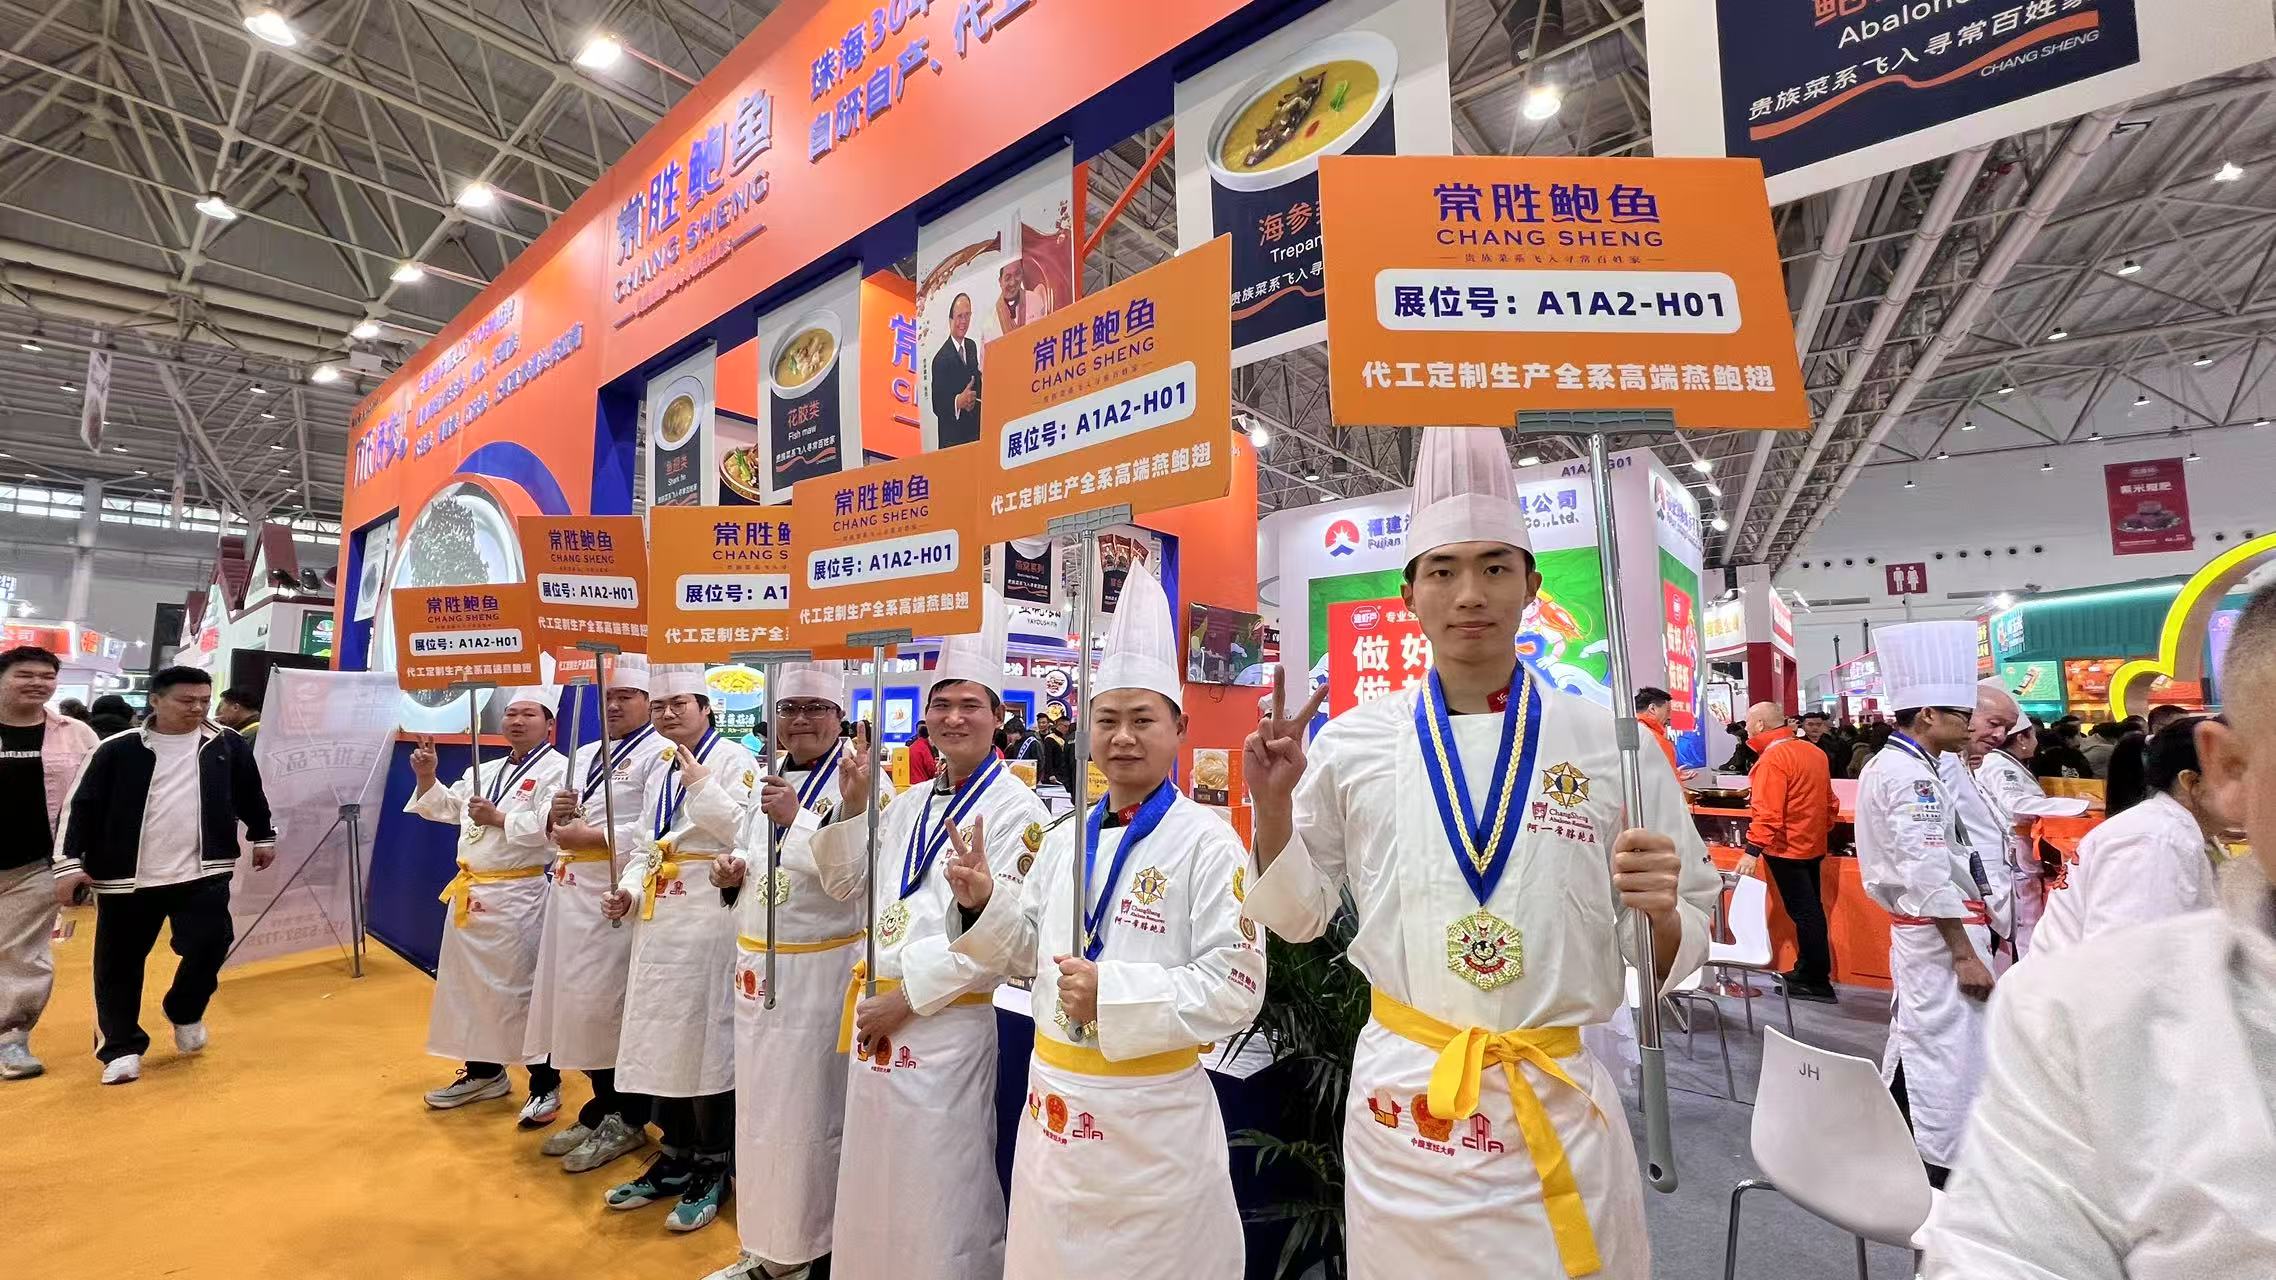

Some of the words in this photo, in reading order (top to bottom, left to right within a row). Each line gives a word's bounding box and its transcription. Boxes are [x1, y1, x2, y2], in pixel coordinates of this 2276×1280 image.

[1981, 49, 2039, 78] CHANG
[2040, 29, 2099, 58] SHENG
[616, 89, 774, 266] 常胜鲍鱼
[1433, 183, 1660, 224] 常胜鲍鱼
[614, 235, 680, 303] CHANG
[685, 170, 769, 256] SHENG
[1258, 201, 1321, 246] 海参
[1436, 229, 1546, 247] CHANG
[1558, 229, 1664, 248] SHENG
[1034, 297, 1156, 374] 常胜鲍鱼
[1031, 363, 1087, 394] CHANG
[1093, 336, 1155, 371] SHENG
[1362, 360, 1776, 393] 代工定制生产全系高端燕鲍翅
[991, 441, 1212, 516] 代工定制生产全系高端燕鲍翅
[834, 475, 929, 517] 常胜鲍鱼
[833, 514, 878, 532] CHANG
[882, 505, 929, 524] SHENG
[549, 529, 613, 551] 常胜鲍鱼
[712, 550, 773, 560] CHANG
[550, 553, 581, 563] CHANG
[583, 554, 615, 564] SHENG
[427, 595, 499, 614] 常胜鲍鱼
[427, 614, 462, 624] CHANG
[466, 613, 500, 621] SHENG
[799, 591, 969, 625] 代工定制生产全系高端燕鲍翅
[1799, 1062, 1819, 1081] JH
